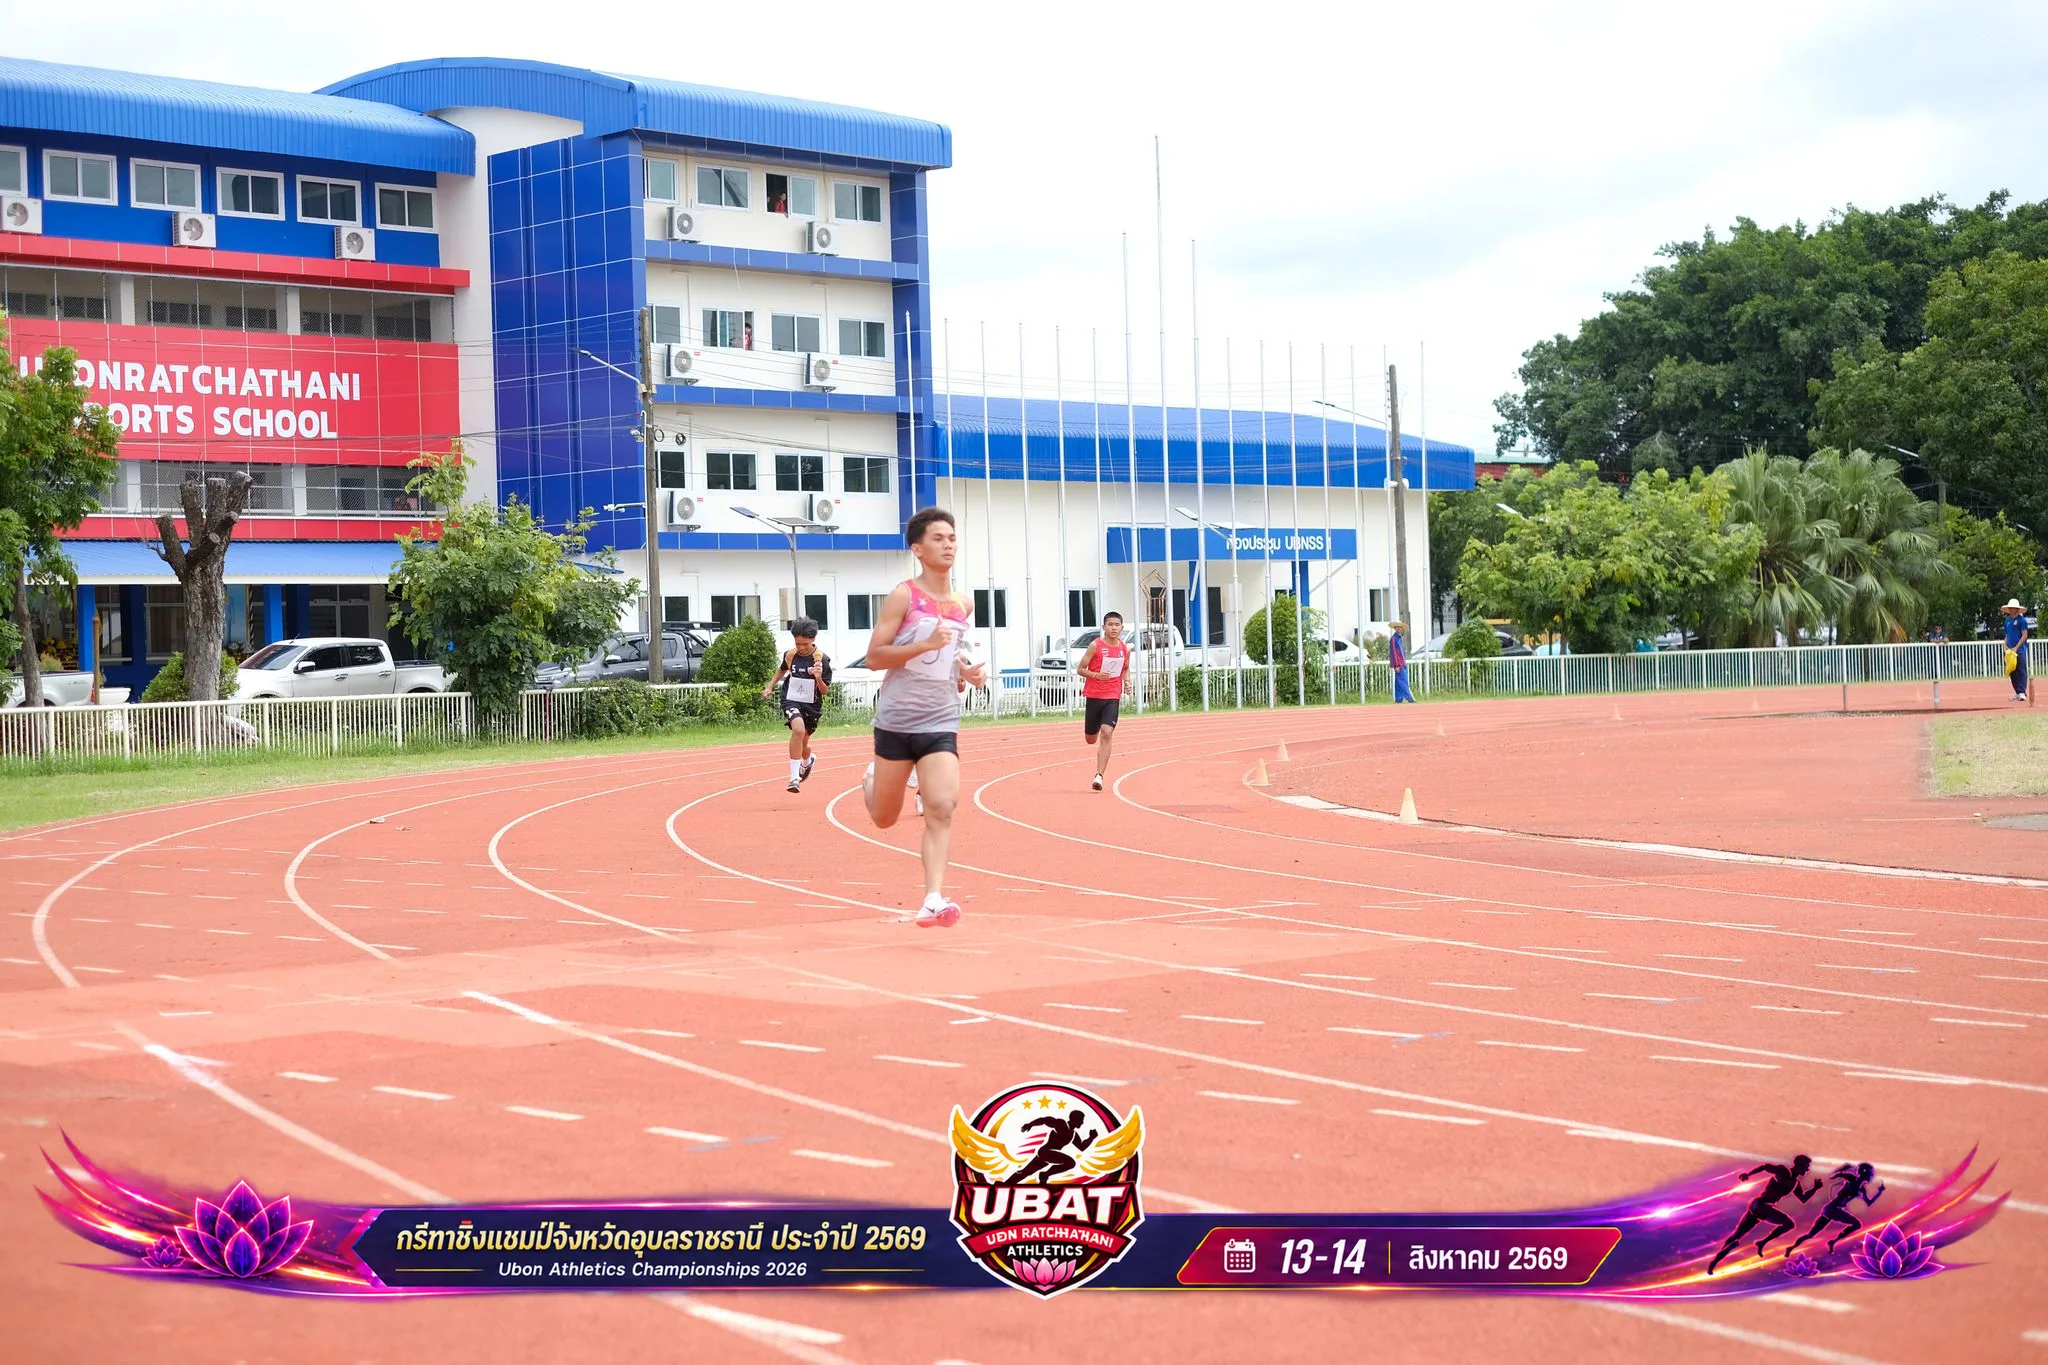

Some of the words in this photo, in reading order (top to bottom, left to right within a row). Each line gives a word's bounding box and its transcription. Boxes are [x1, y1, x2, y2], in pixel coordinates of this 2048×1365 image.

[19, 355, 361, 400] UONRATCHATHANI
[213, 406, 338, 439] SCHOOL
[797, 683, 805, 696] 4
